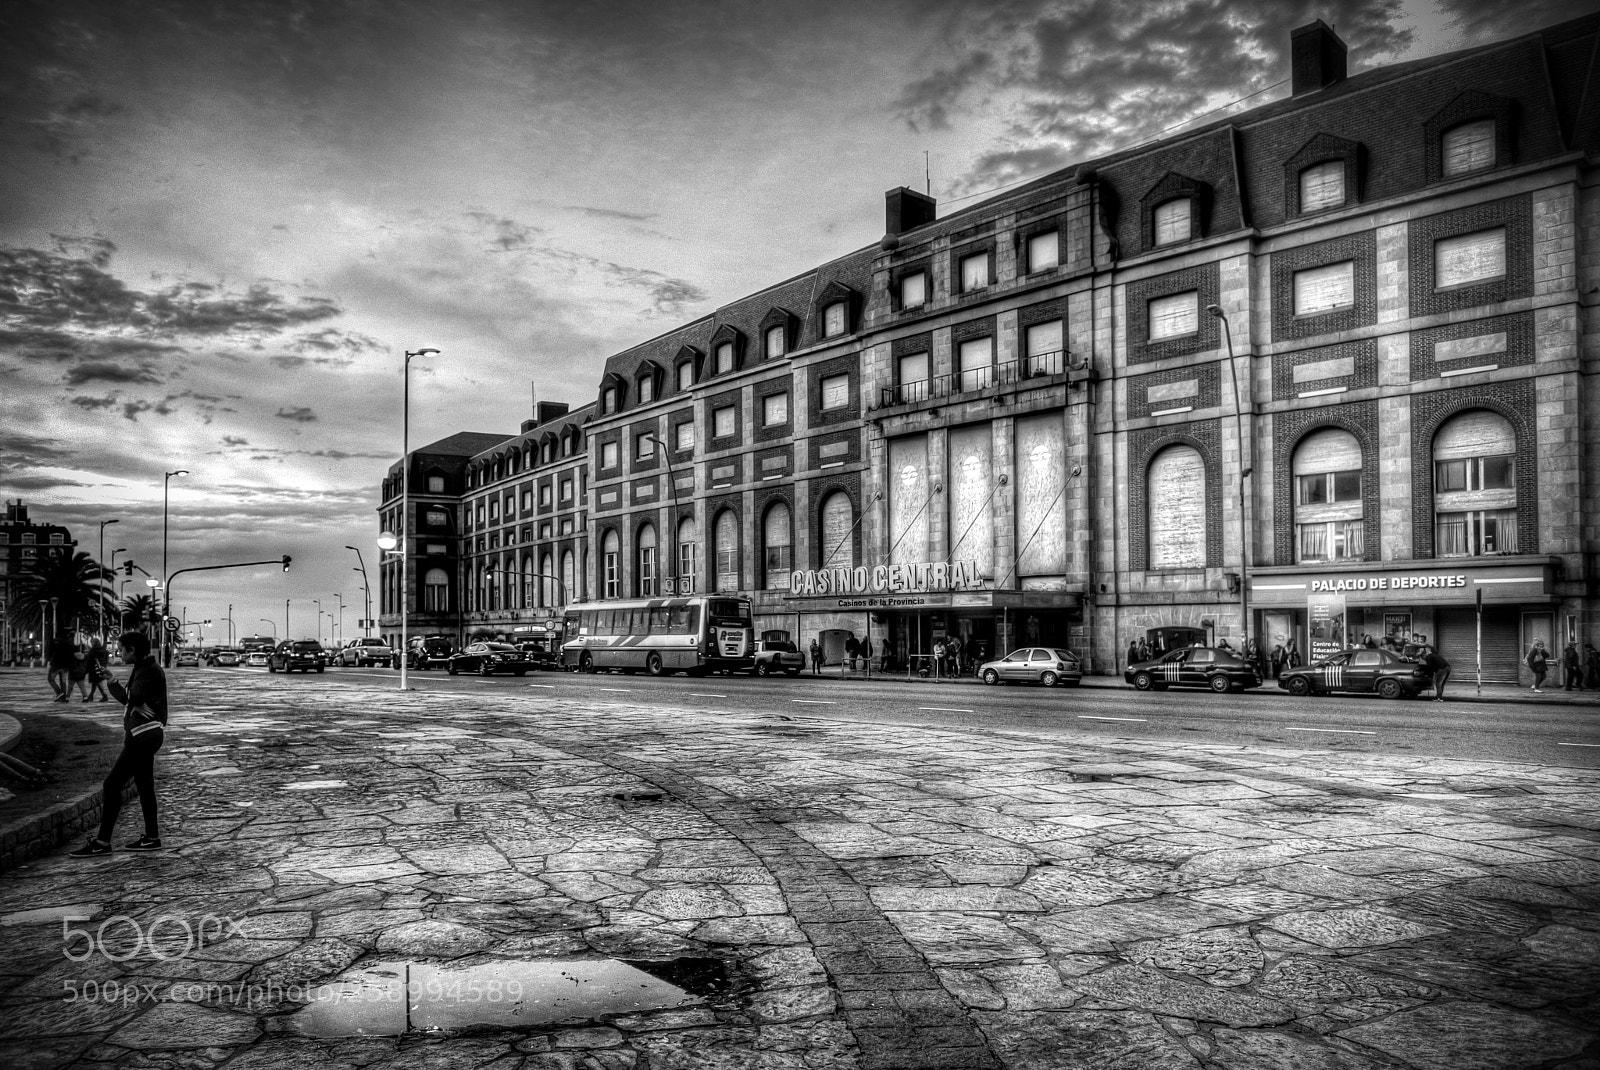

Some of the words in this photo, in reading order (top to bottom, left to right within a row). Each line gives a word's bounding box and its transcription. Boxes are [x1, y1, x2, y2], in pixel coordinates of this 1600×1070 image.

[791, 566, 869, 594] CASINO
[873, 560, 982, 590] CENTRAL
[1312, 579, 1367, 591] PALACIO
[1370, 578, 1387, 589] DE
[1391, 575, 1466, 588] DEPORTES
[838, 599, 867, 607] Casinos
[889, 597, 925, 605] Provincia
